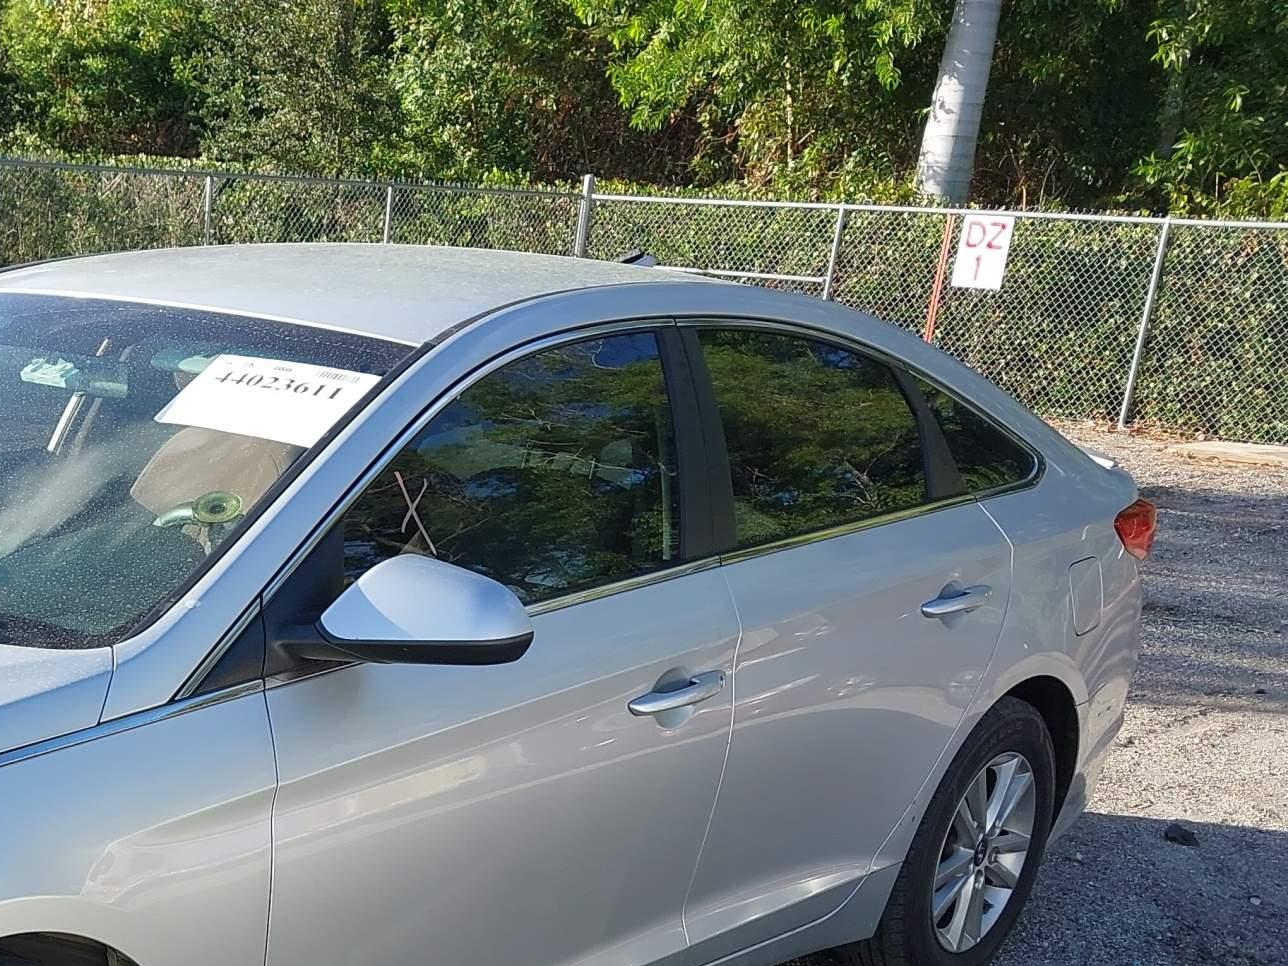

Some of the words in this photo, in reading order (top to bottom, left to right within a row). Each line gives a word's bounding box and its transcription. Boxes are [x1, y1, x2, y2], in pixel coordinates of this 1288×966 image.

[966, 221, 1006, 249] DZ
[974, 255, 982, 281] 1
[215, 371, 343, 400] 44023611
